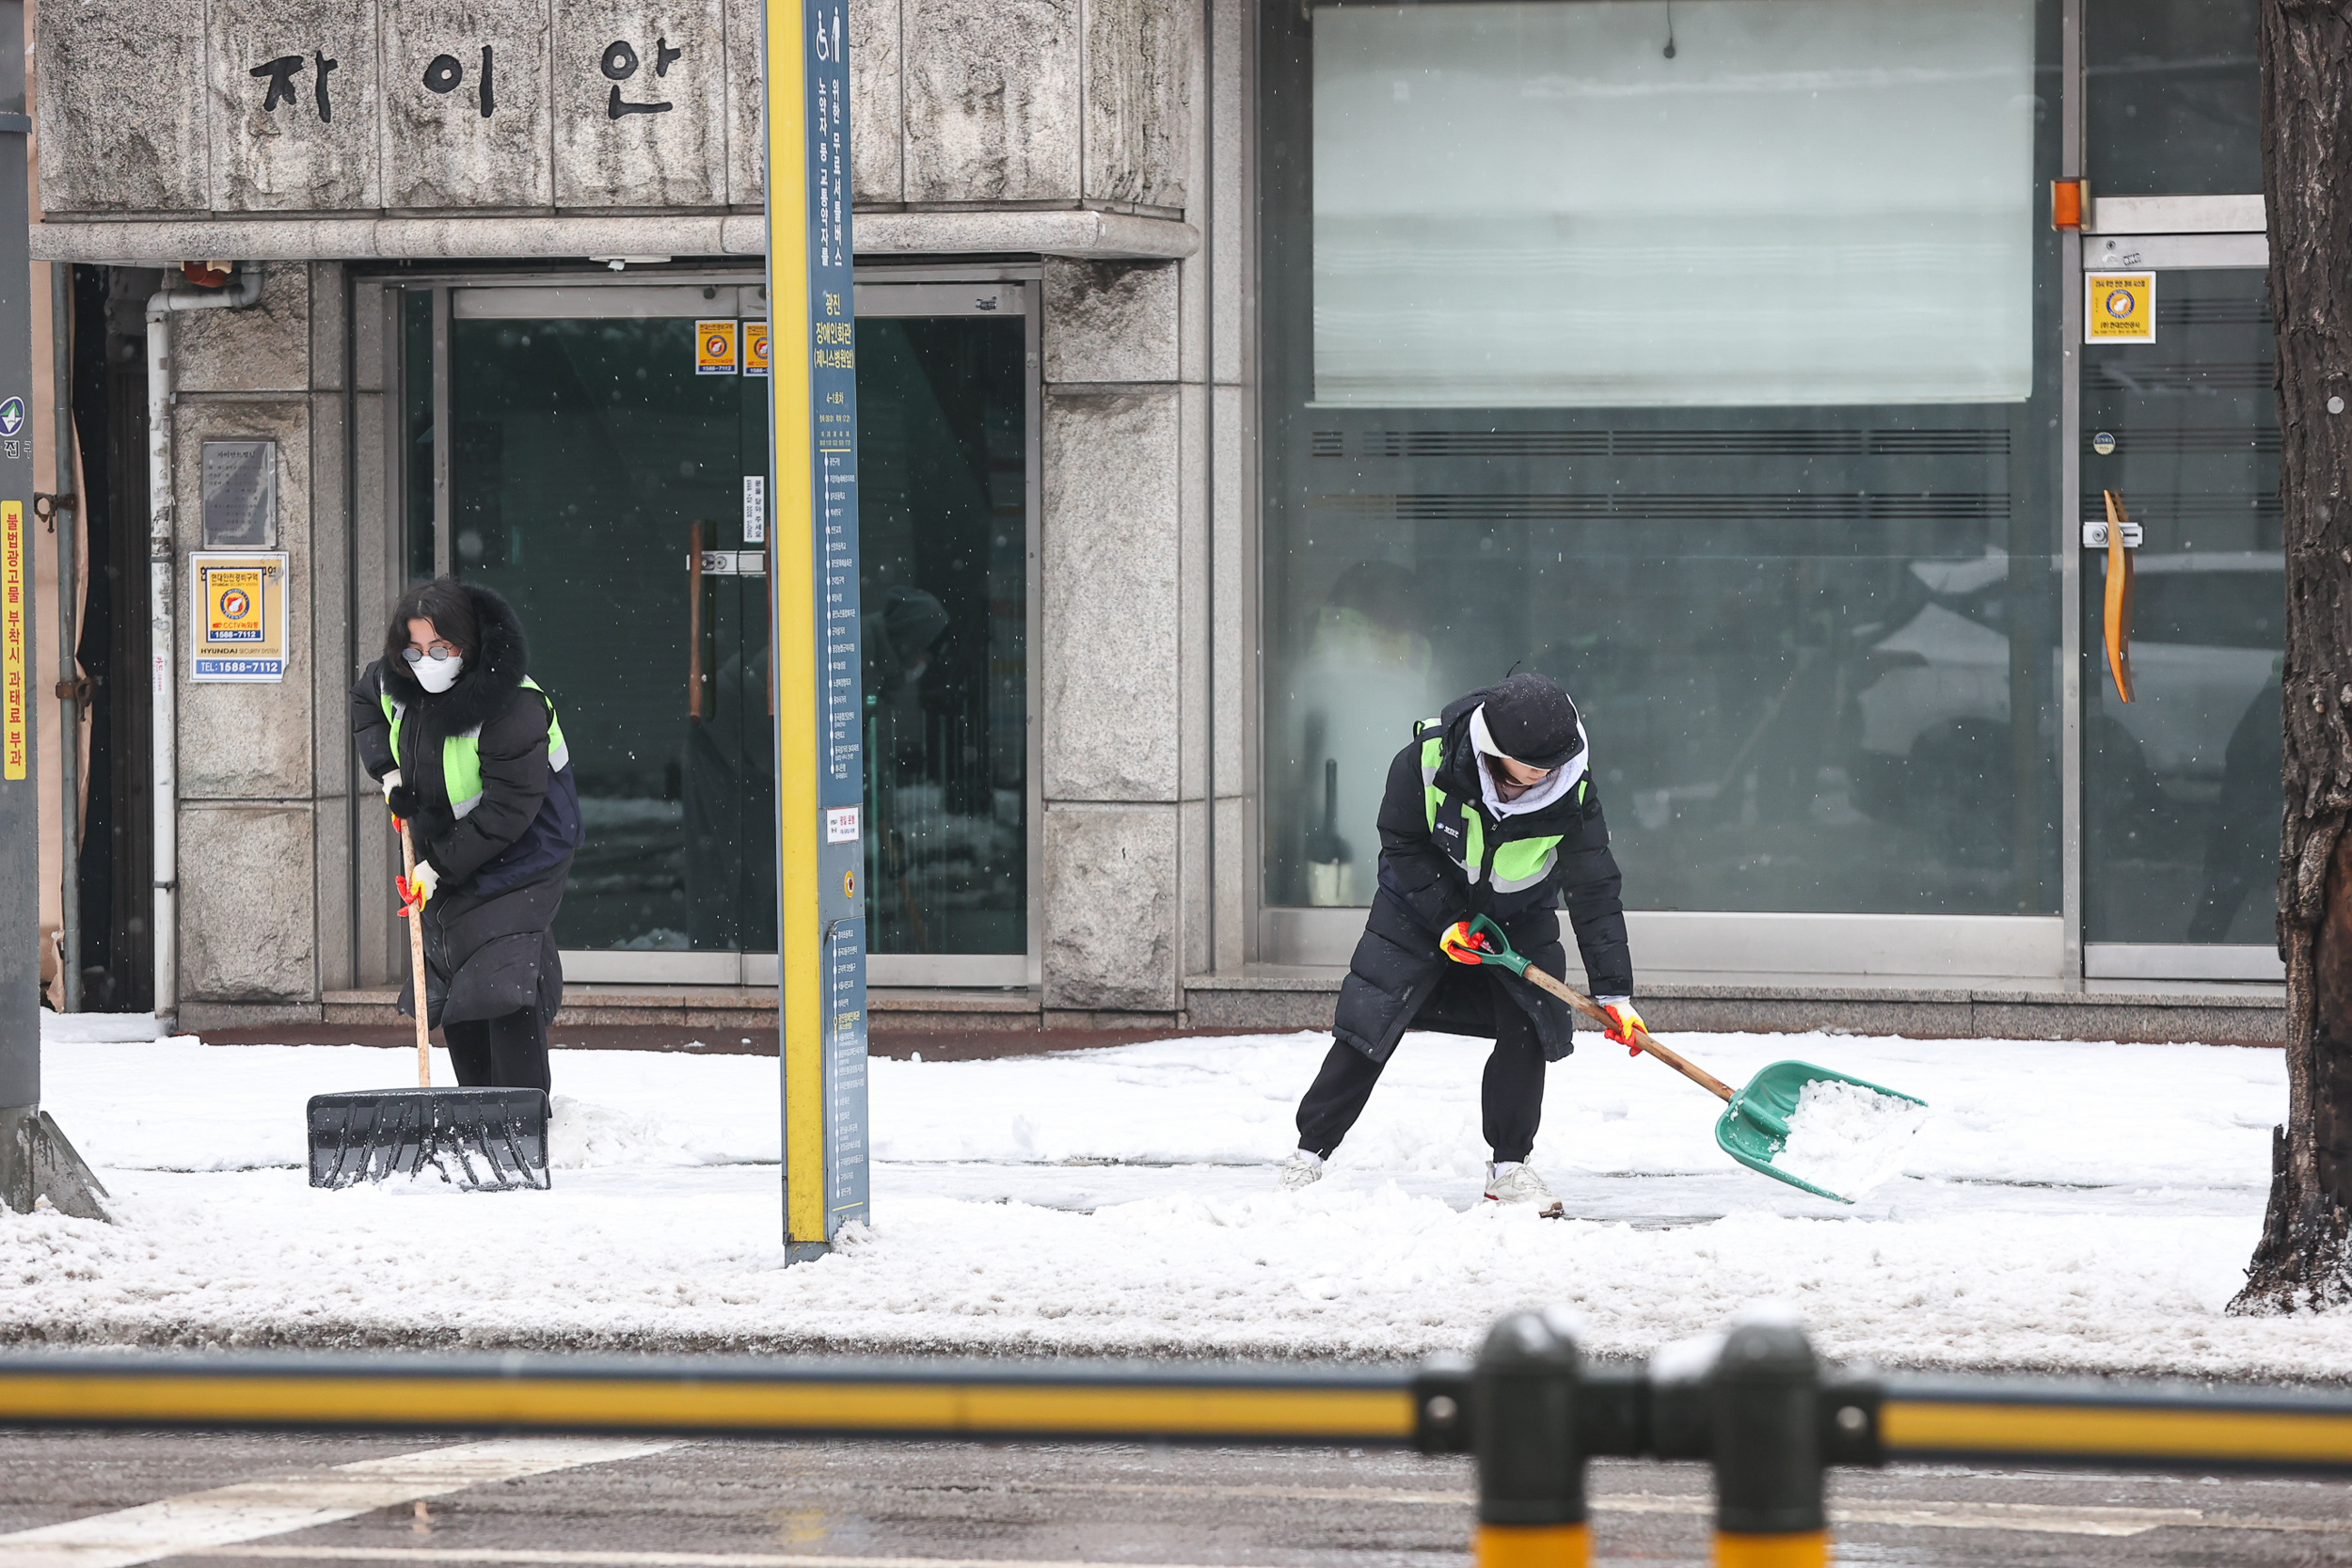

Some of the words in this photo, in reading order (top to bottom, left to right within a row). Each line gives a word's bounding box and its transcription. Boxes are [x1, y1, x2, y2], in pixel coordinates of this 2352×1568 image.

[818, 76, 828, 137] 노약자
[832, 78, 840, 124] 위한
[819, 168, 829, 266] 교통약자를
[833, 131, 843, 267] 무료셔틀버스
[825, 293, 842, 316] 광진
[813, 347, 854, 369] (제니스병원앞)
[816, 321, 852, 345] 장애인회관
[6, 513, 19, 603] 불법광고물
[8, 610, 21, 664] 부착시
[8, 671, 22, 724] 과태료
[9, 731, 23, 767] 부과
